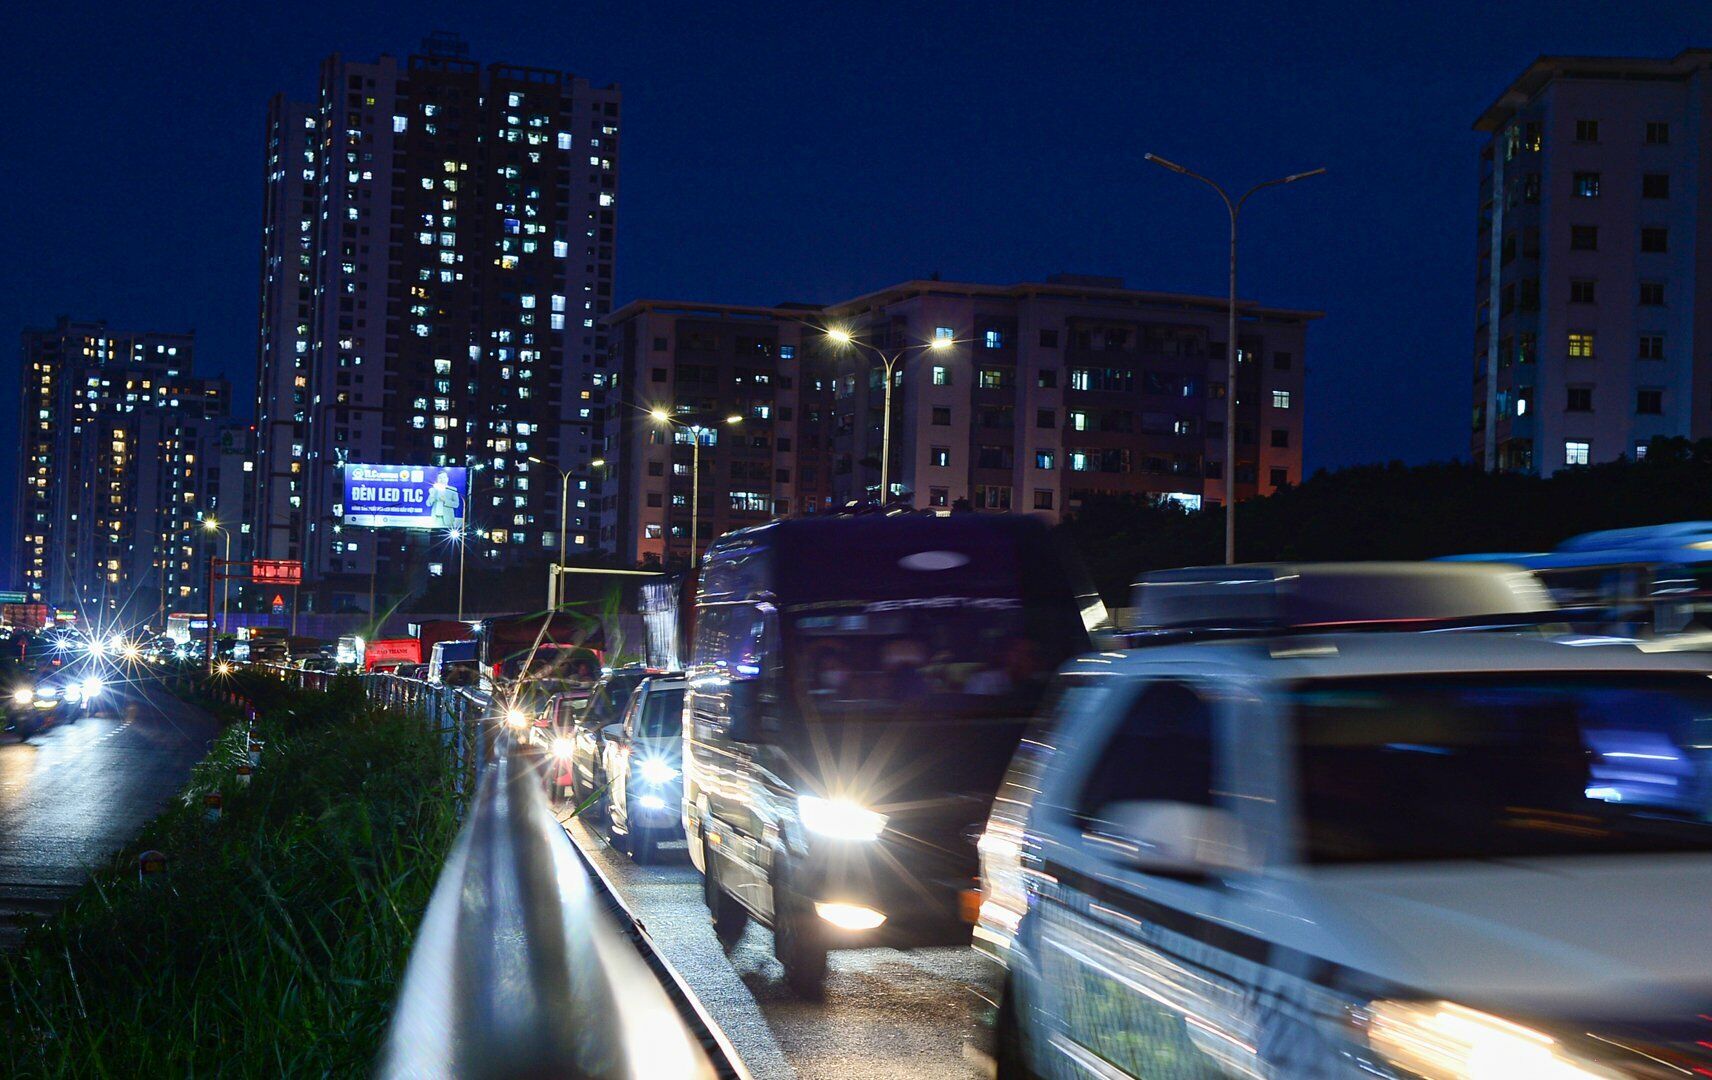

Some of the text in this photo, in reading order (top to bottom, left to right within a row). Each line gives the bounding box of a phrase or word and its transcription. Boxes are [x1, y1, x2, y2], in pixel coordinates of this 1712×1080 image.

[352, 485, 423, 503] ĐÈN LED TLC
